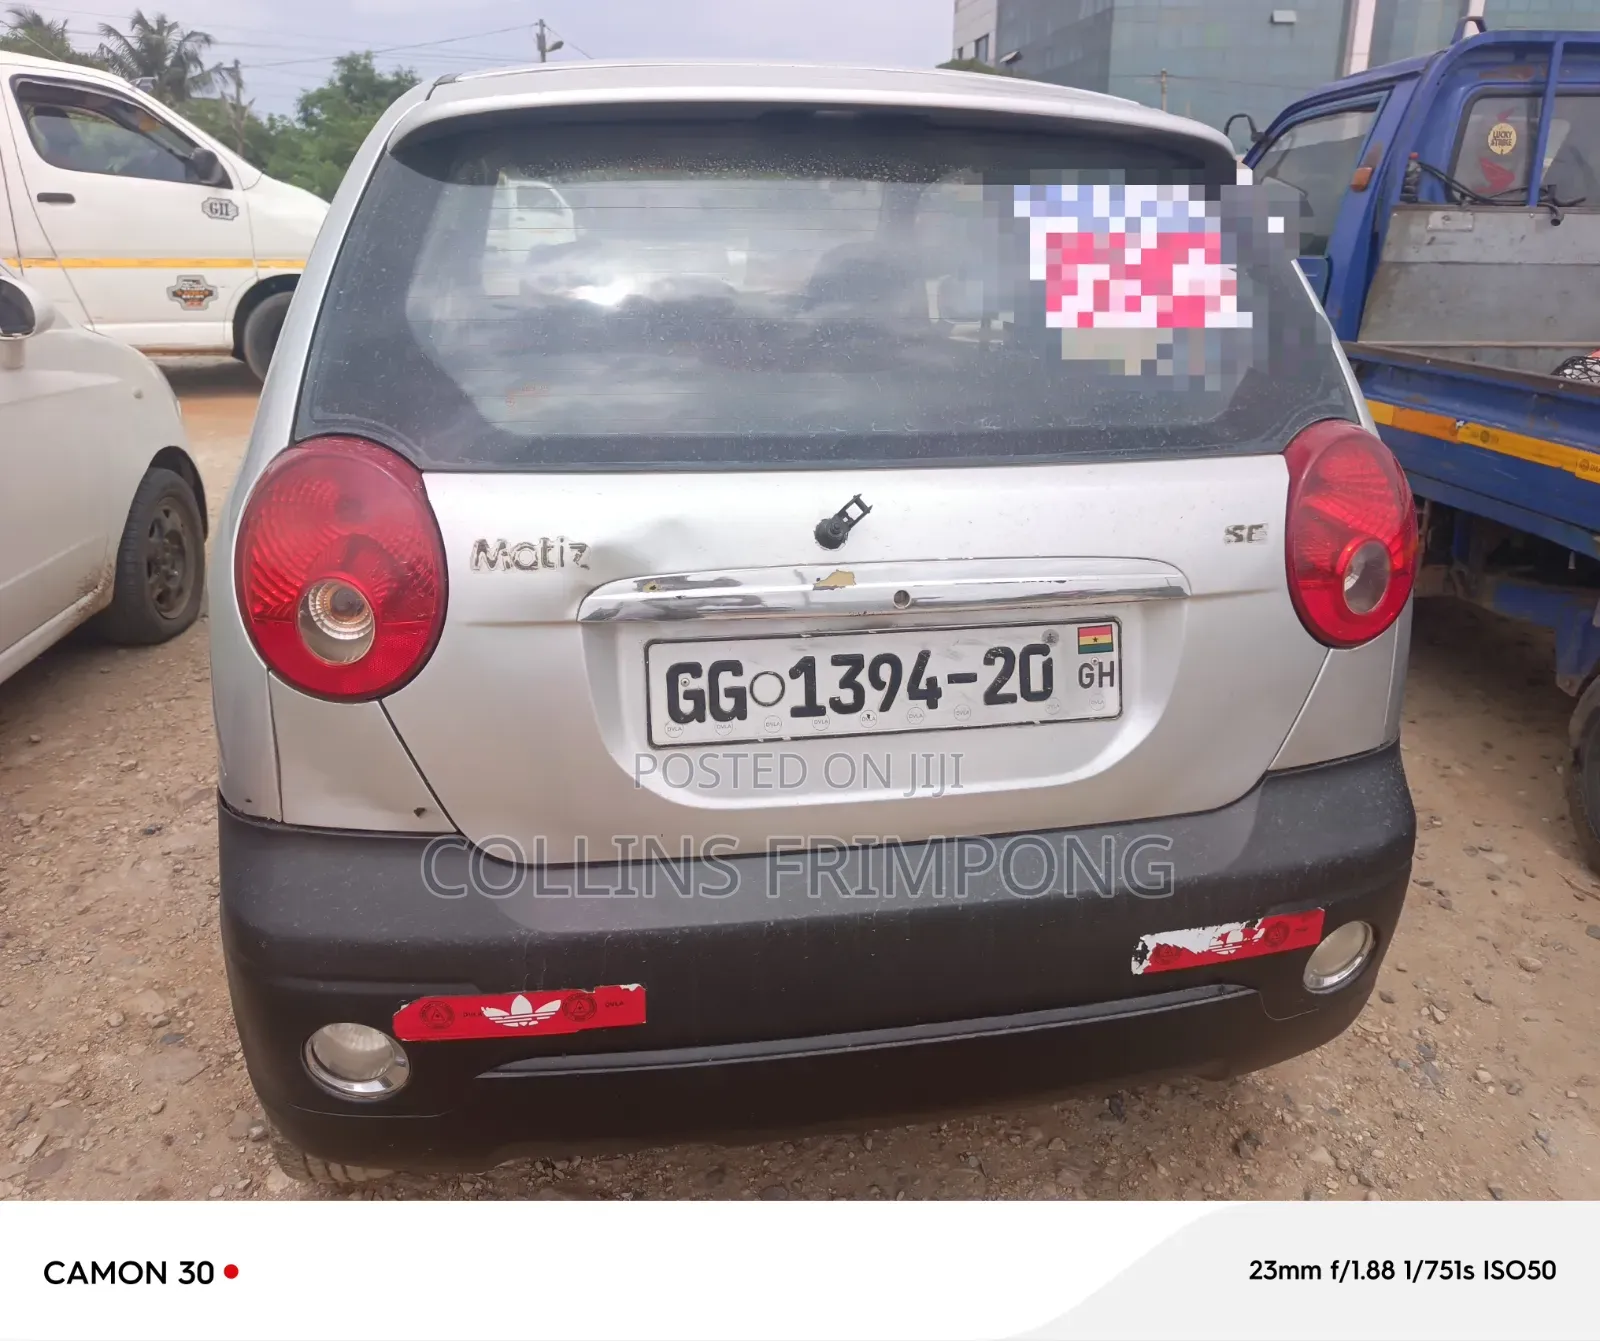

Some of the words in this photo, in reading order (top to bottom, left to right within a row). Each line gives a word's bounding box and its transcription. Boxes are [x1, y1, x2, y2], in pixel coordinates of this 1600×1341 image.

[1491, 138, 1513, 146] STKE
[470, 536, 591, 572] Matiz
[665, 660, 748, 724] GG
[789, 642, 1054, 718] 1394-20
[1078, 660, 1115, 689] GH
